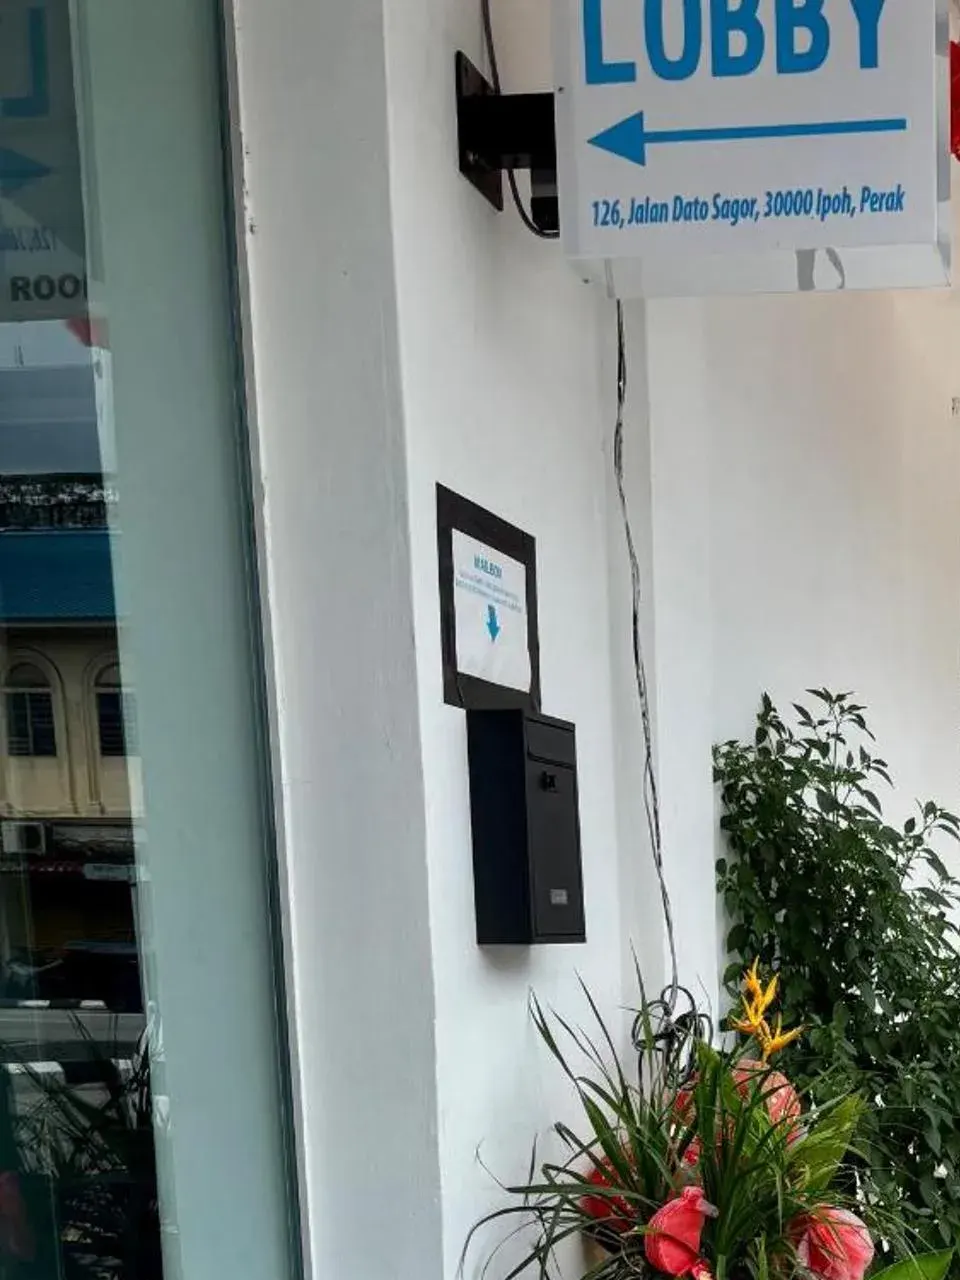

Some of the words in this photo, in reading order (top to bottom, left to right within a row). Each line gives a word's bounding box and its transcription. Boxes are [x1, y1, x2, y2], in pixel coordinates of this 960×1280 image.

[582, 0, 886, 85] LOBBY
[592, 199, 625, 229] 126,
[628, 196, 669, 225] Jalan
[672, 194, 709, 222] Dato
[712, 192, 760, 227] Sagor,
[764, 188, 814, 218] 30000
[816, 186, 857, 222] Ipoh,
[860, 183, 906, 213] Perak
[10, 273, 88, 302] ROO
